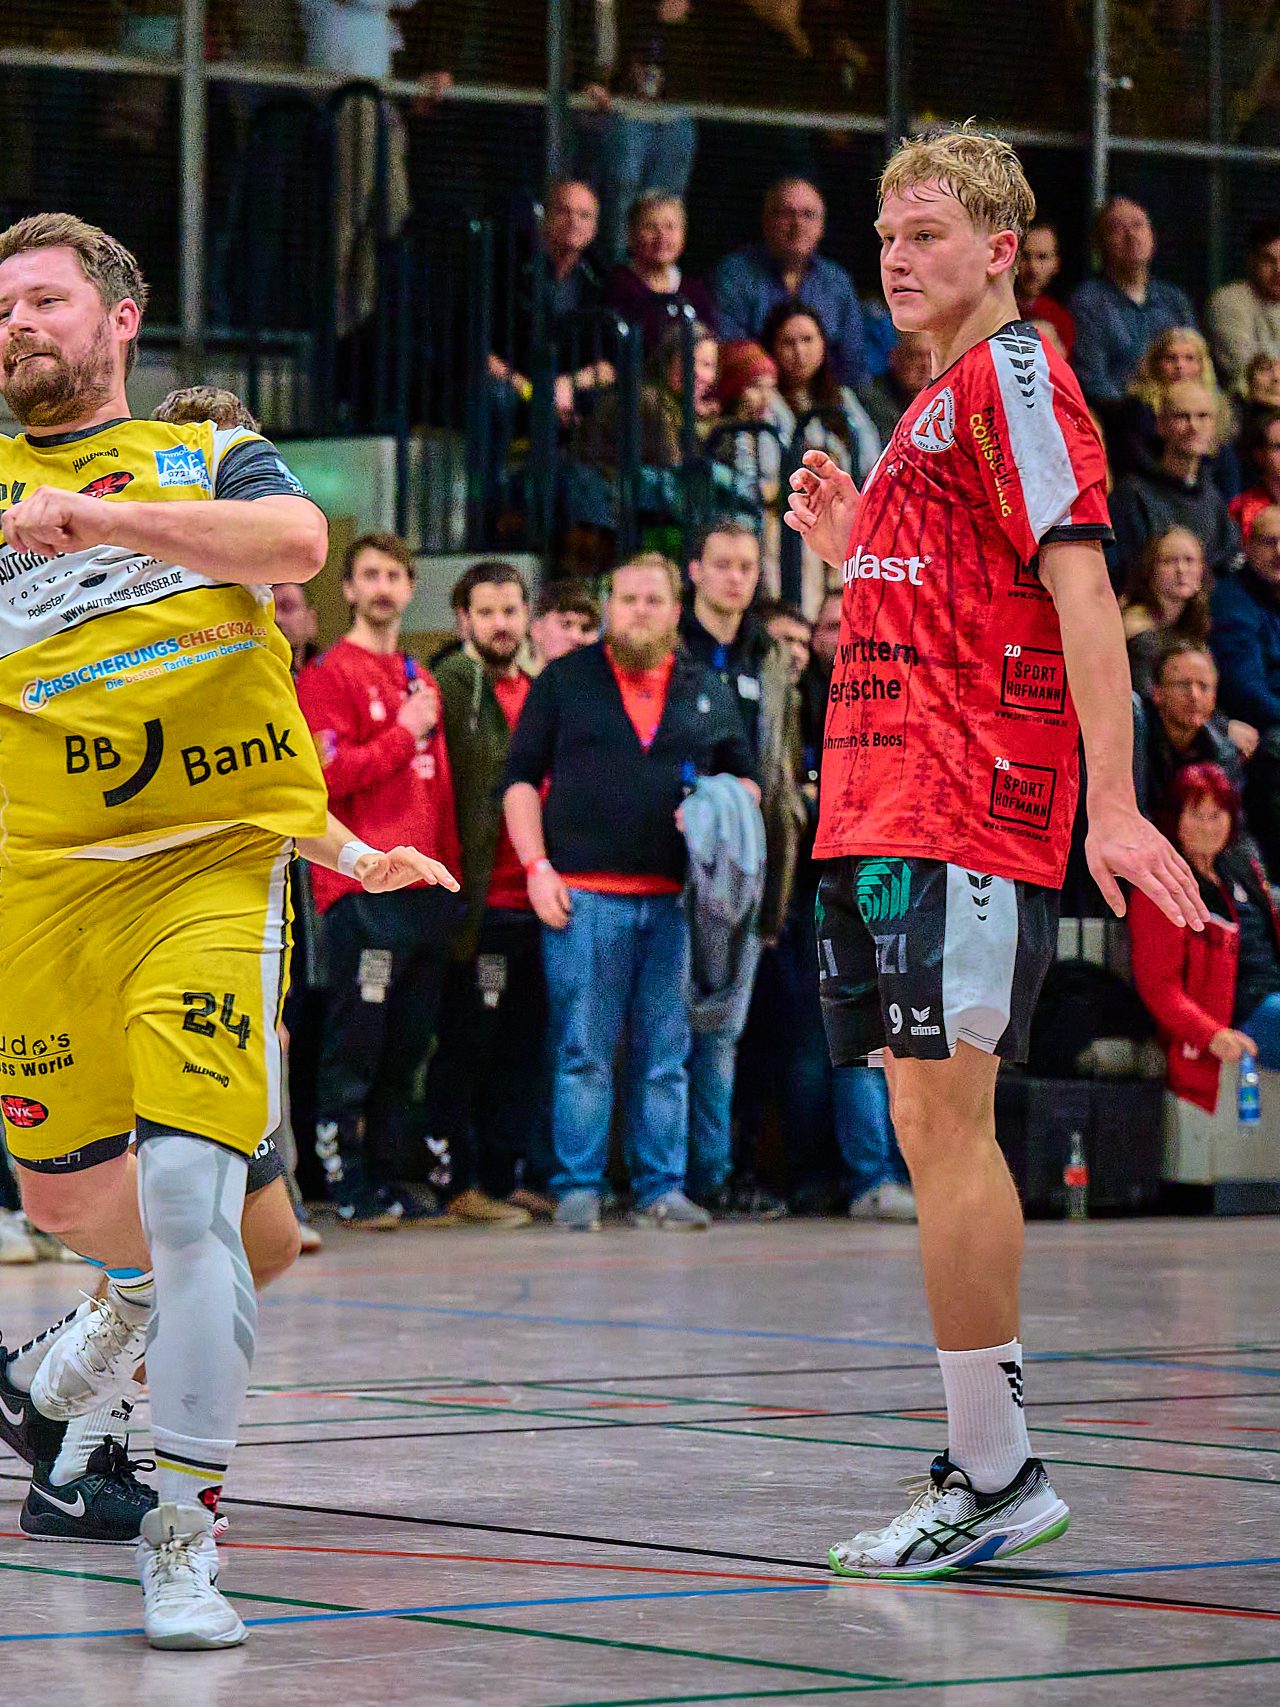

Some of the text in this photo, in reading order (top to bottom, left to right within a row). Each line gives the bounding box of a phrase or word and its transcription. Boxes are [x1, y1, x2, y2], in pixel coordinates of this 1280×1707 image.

[72, 447, 119, 474] HALLENKIND
[27, 593, 67, 620] Polestar
[105, 678, 125, 691] Die
[125, 667, 163, 685] besten
[162, 656, 194, 673] Tarife
[195, 649, 219, 663] zum
[1014, 660, 1057, 682] SPORT
[1006, 681, 1062, 701] HOFMANN
[860, 732, 870, 747] &
[873, 732, 903, 747] Boos
[65, 722, 298, 786] BB Bank
[1003, 774, 1045, 798] SPORT
[995, 792, 1047, 817] HOFMANN
[182, 991, 251, 1050] 24
[888, 1002, 904, 1035] 9
[910, 1023, 941, 1036] erima
[20, 1053, 75, 1077] World
[182, 1060, 231, 1088] HALLENKIND
[7, 1106, 33, 1118] TVK
